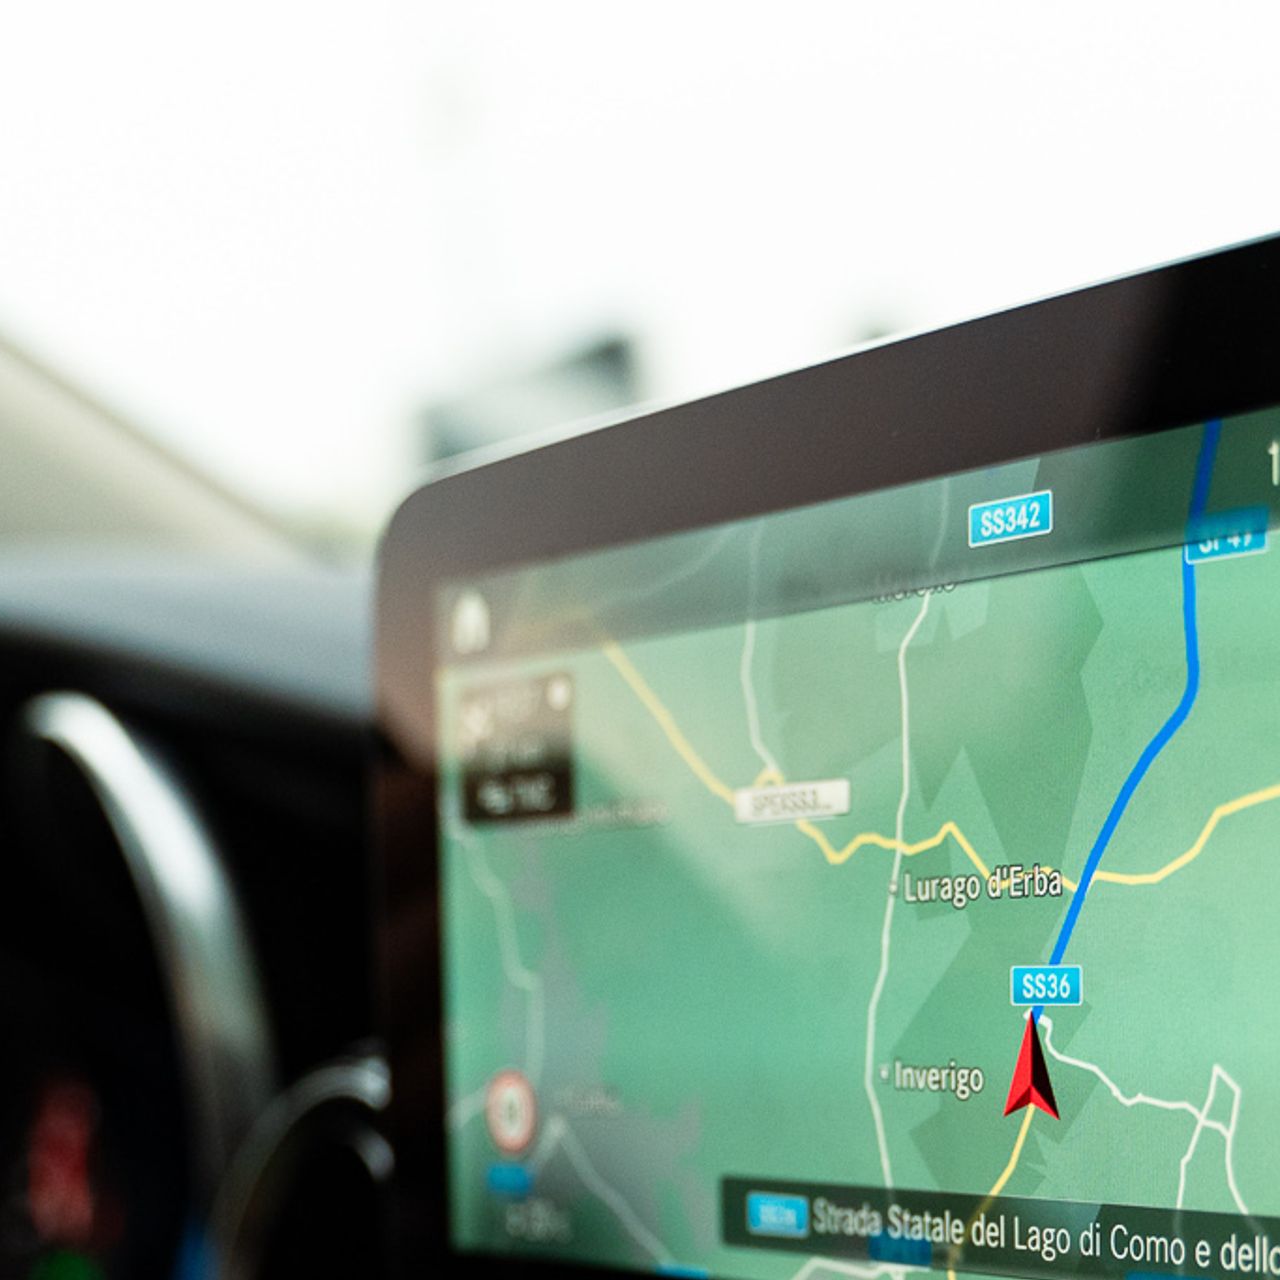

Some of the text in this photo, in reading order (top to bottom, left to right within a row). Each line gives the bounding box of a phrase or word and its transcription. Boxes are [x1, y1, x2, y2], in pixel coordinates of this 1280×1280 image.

[980, 501, 1041, 537] SS342
[903, 863, 1063, 909] Lurago d'Erba
[1021, 972, 1072, 999] SS36
[894, 1060, 985, 1100] Inverigo
[812, 1197, 884, 1238] Strada
[887, 1203, 965, 1246] Statale
[970, 1212, 1006, 1249] del
[1013, 1215, 1071, 1262] Lago
[1078, 1221, 1102, 1258] di
[1109, 1223, 1186, 1266] Como
[1194, 1239, 1212, 1268] e
